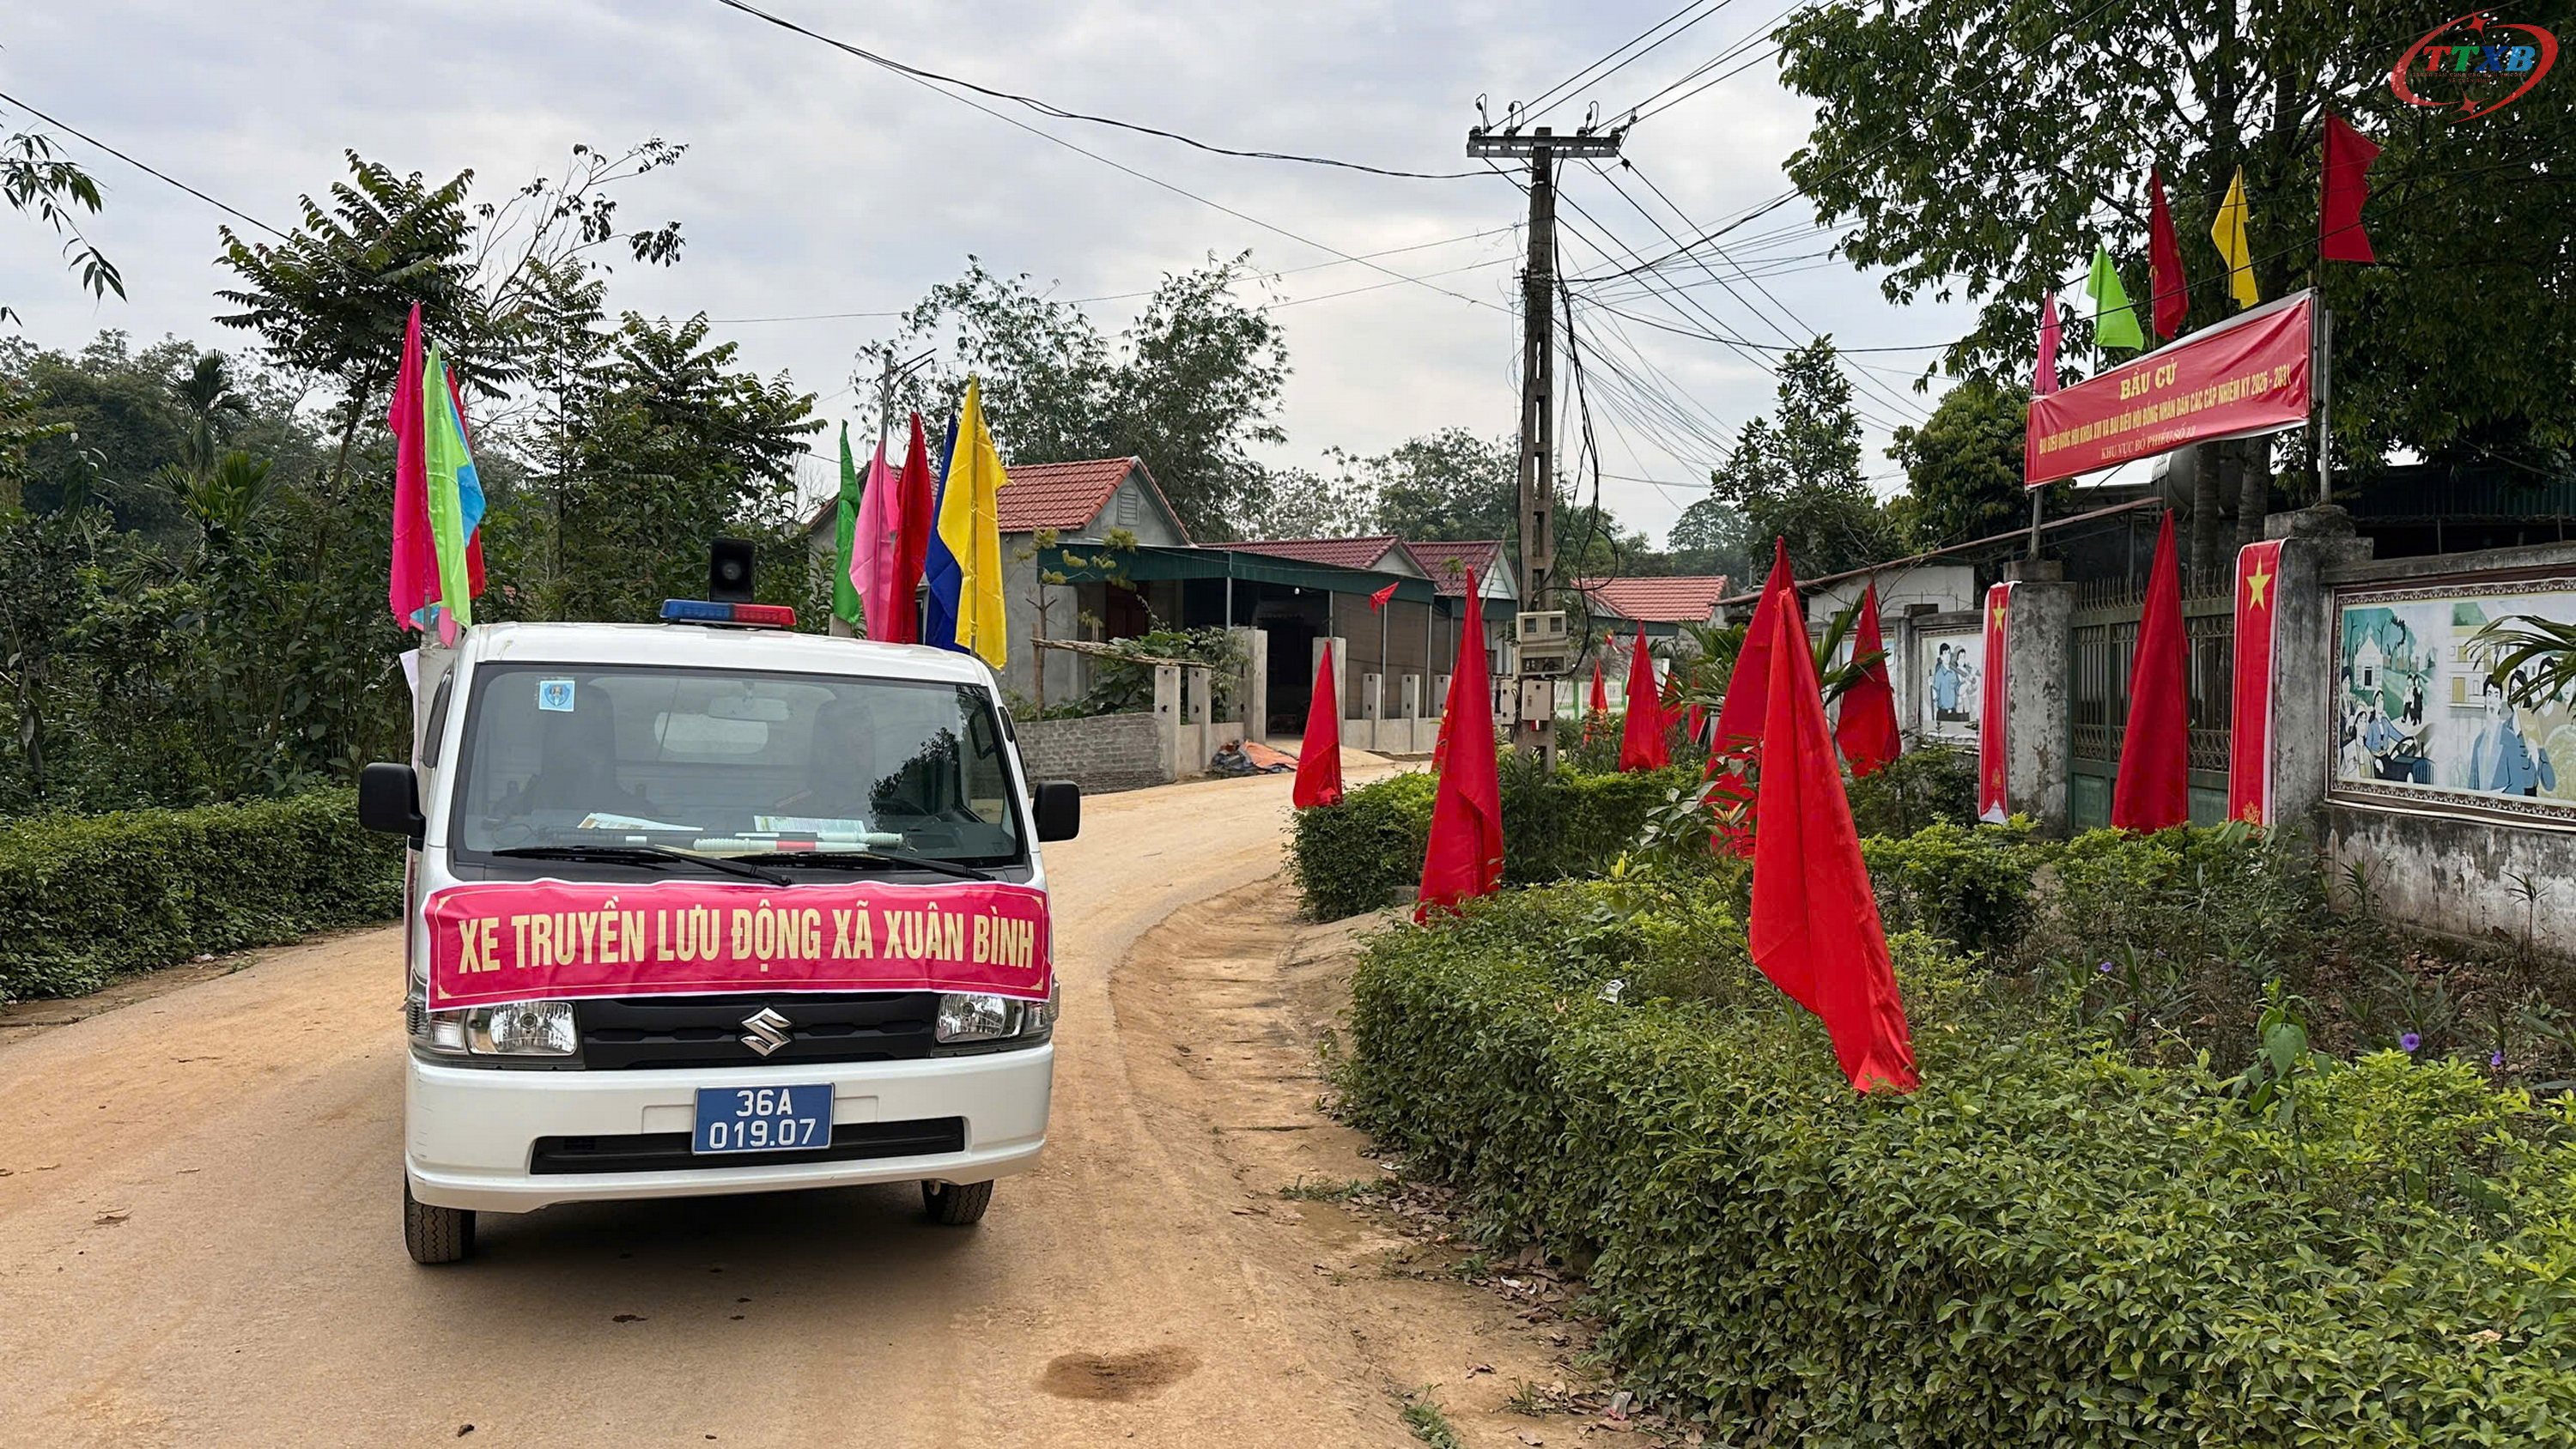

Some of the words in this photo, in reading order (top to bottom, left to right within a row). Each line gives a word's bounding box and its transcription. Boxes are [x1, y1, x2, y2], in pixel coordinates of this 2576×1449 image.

[2120, 367, 2151, 401] BẦU
[2154, 357, 2178, 389] CỬ
[2159, 397, 2176, 421] NHÂN
[2177, 392, 2190, 416] DÂN
[2190, 389, 2203, 413] CÁC
[2204, 380, 2217, 409] CẤP
[2218, 377, 2240, 407] NHIỆM
[2241, 373, 2251, 398] KỲ
[2251, 371, 2269, 396] 2026
[2273, 363, 2292, 390] 2031
[2101, 446, 2117, 460] KHU
[2135, 433, 2147, 452] BỎ
[2147, 427, 2173, 447] PHIẾU
[2173, 421, 2186, 442] SỐ
[458, 917, 501, 974] XE
[511, 895, 646, 969] TRUYỀN
[658, 904, 720, 962] LƯU
[731, 899, 821, 972] ĐỘNG
[831, 900, 874, 960] XÃ
[883, 901, 964, 961] XUÂN
[974, 906, 1034, 968] BÌNH
[736, 1088, 793, 1117] 36A
[708, 1119, 817, 1149] 019.07
